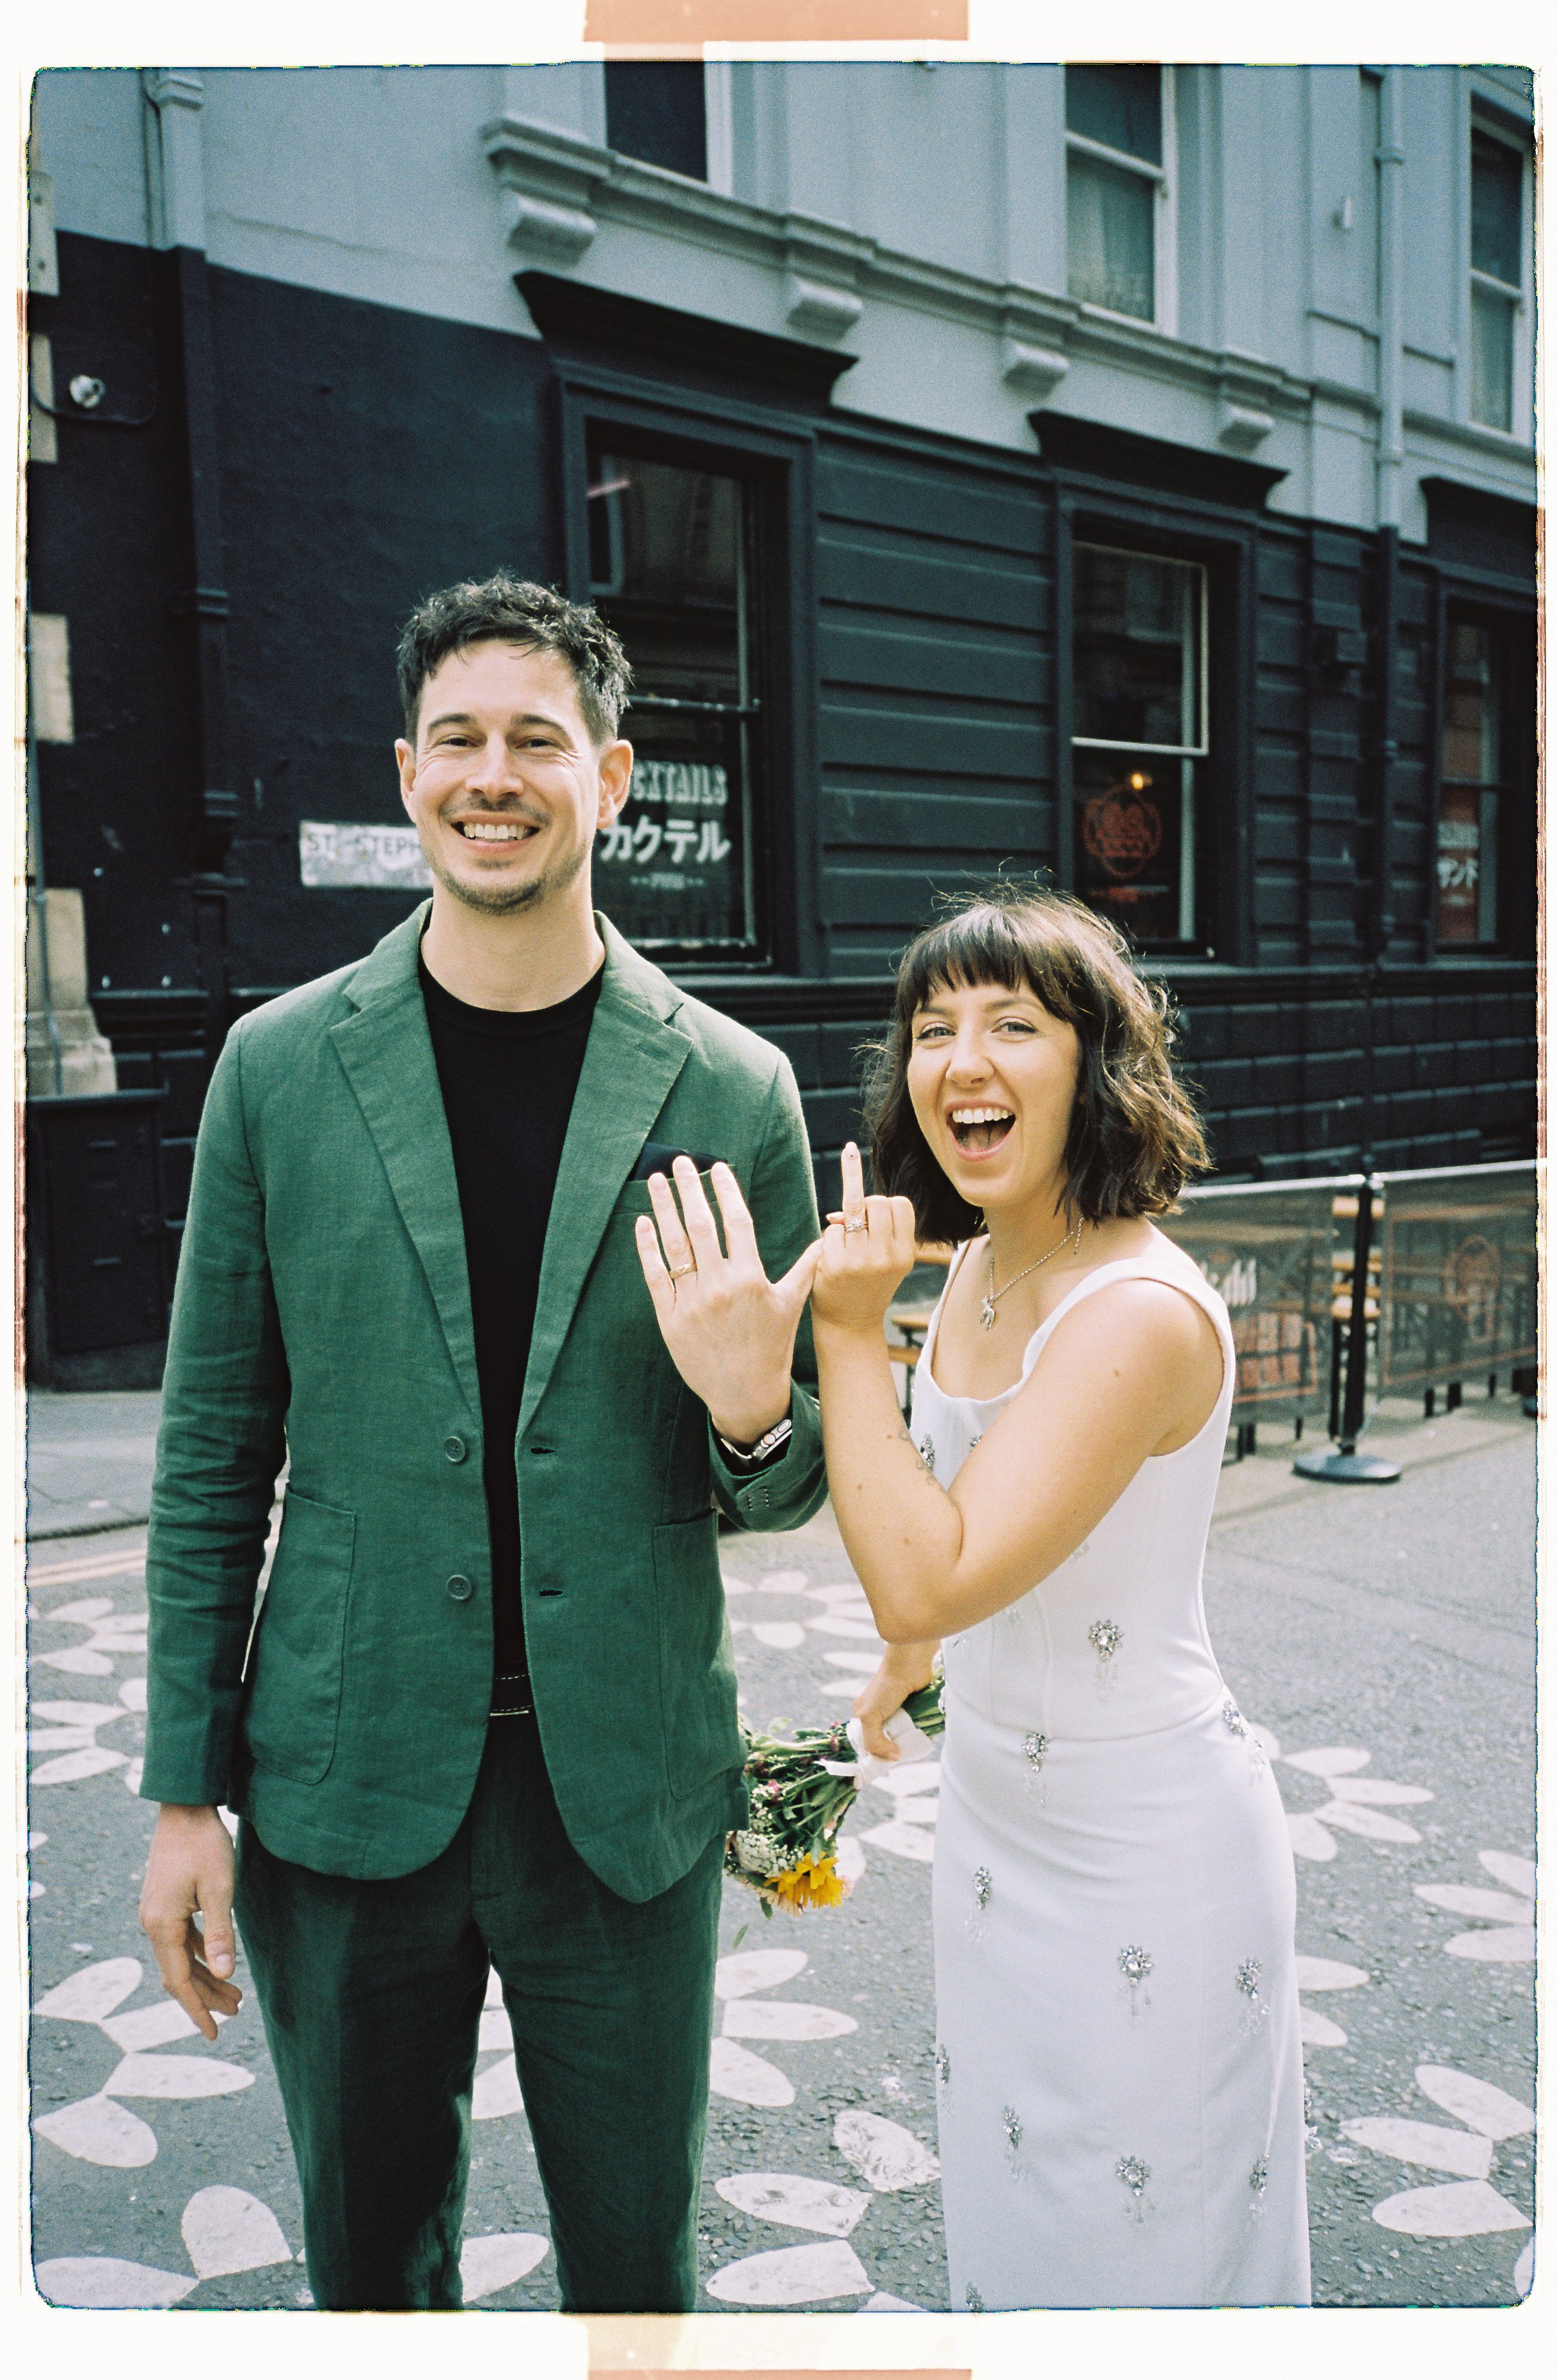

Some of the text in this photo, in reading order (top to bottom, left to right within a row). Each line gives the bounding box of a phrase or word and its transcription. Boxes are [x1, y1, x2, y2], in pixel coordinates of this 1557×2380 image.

[633, 759, 729, 806] CKTAILS
[354, 835, 424, 857] STEPH
[599, 815, 732, 864] カクテル
